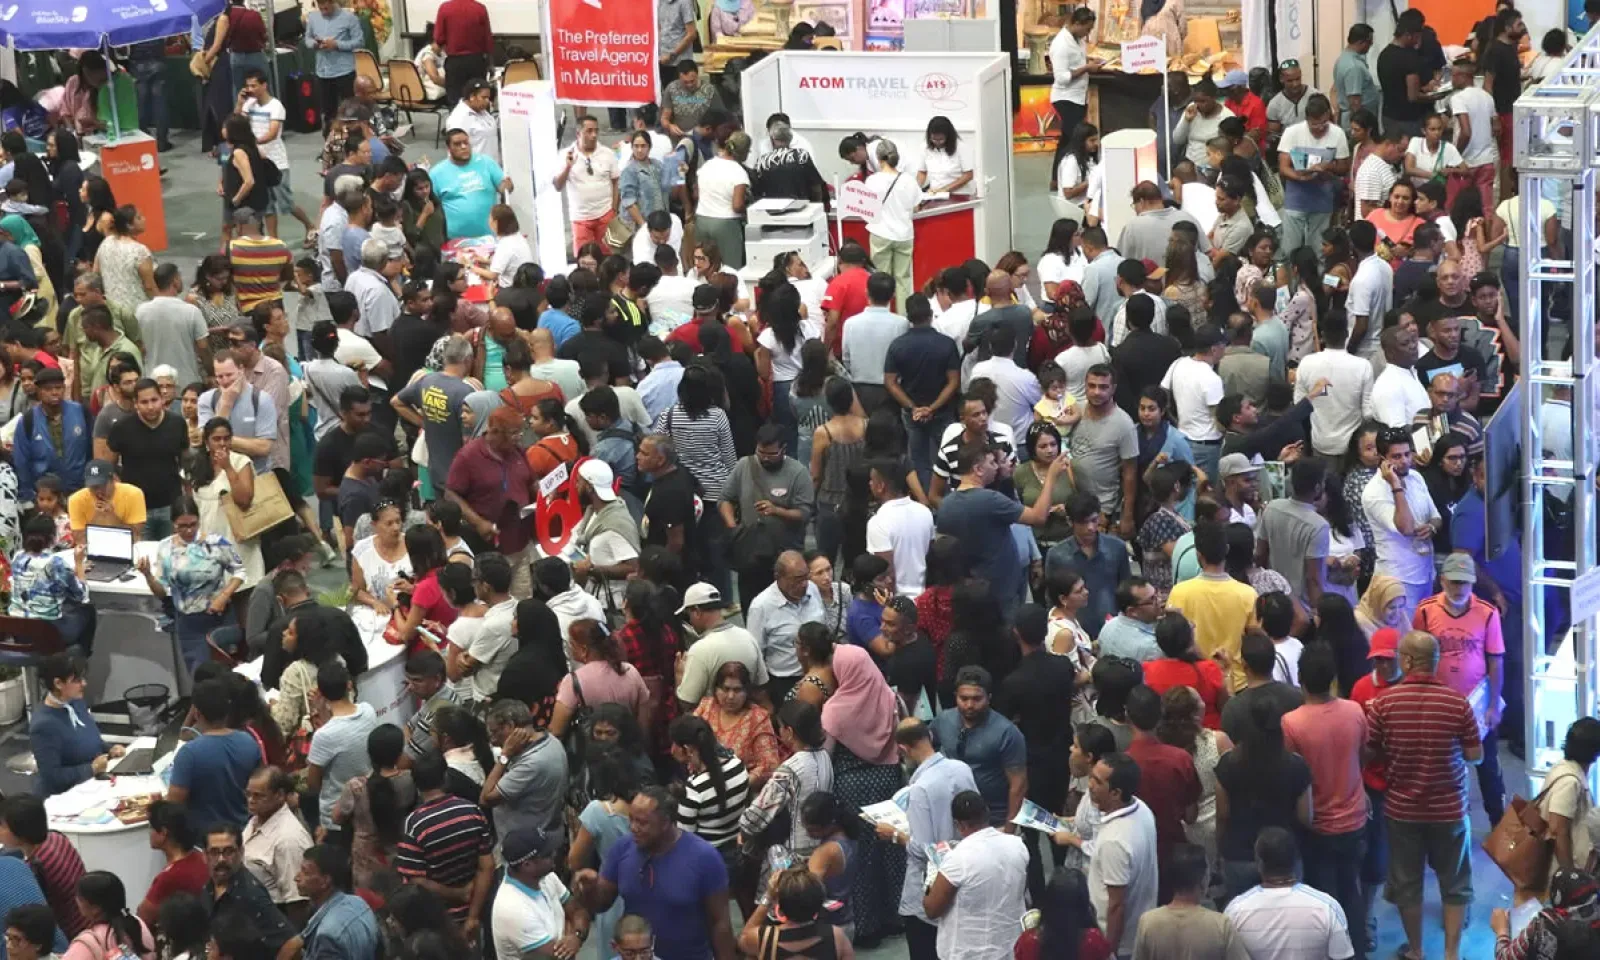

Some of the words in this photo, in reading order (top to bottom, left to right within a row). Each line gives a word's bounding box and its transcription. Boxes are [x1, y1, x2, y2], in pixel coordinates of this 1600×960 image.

[557, 29, 583, 43] The
[585, 30, 650, 45] Preferred
[558, 46, 599, 62] Travel
[600, 48, 650, 66] Agency
[560, 68, 573, 84] in
[574, 68, 648, 87] Mauritius
[868, 90, 909, 99] SERVICE
[422, 388, 448, 410] VANS
[545, 476, 556, 490] UP
[555, 470, 565, 482] TO
